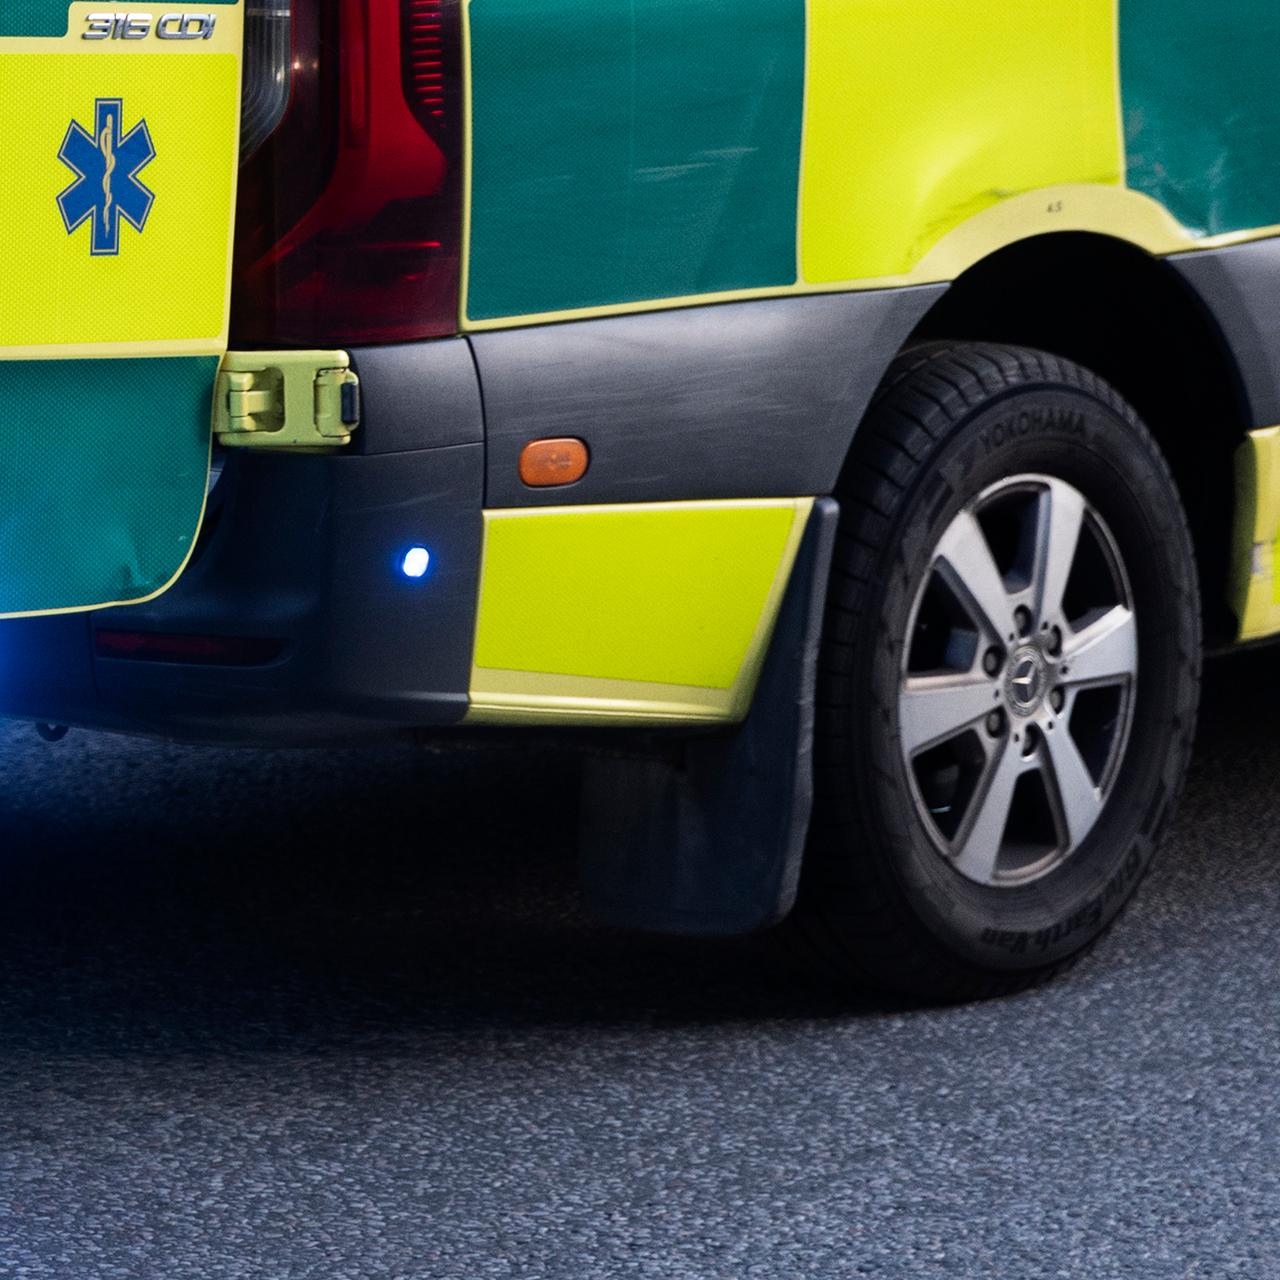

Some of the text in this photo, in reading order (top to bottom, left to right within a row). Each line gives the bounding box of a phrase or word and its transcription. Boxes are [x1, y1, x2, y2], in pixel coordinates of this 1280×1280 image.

[82, 12, 216, 40] 316 CDI
[978, 408, 1087, 454] YOKOHAMA
